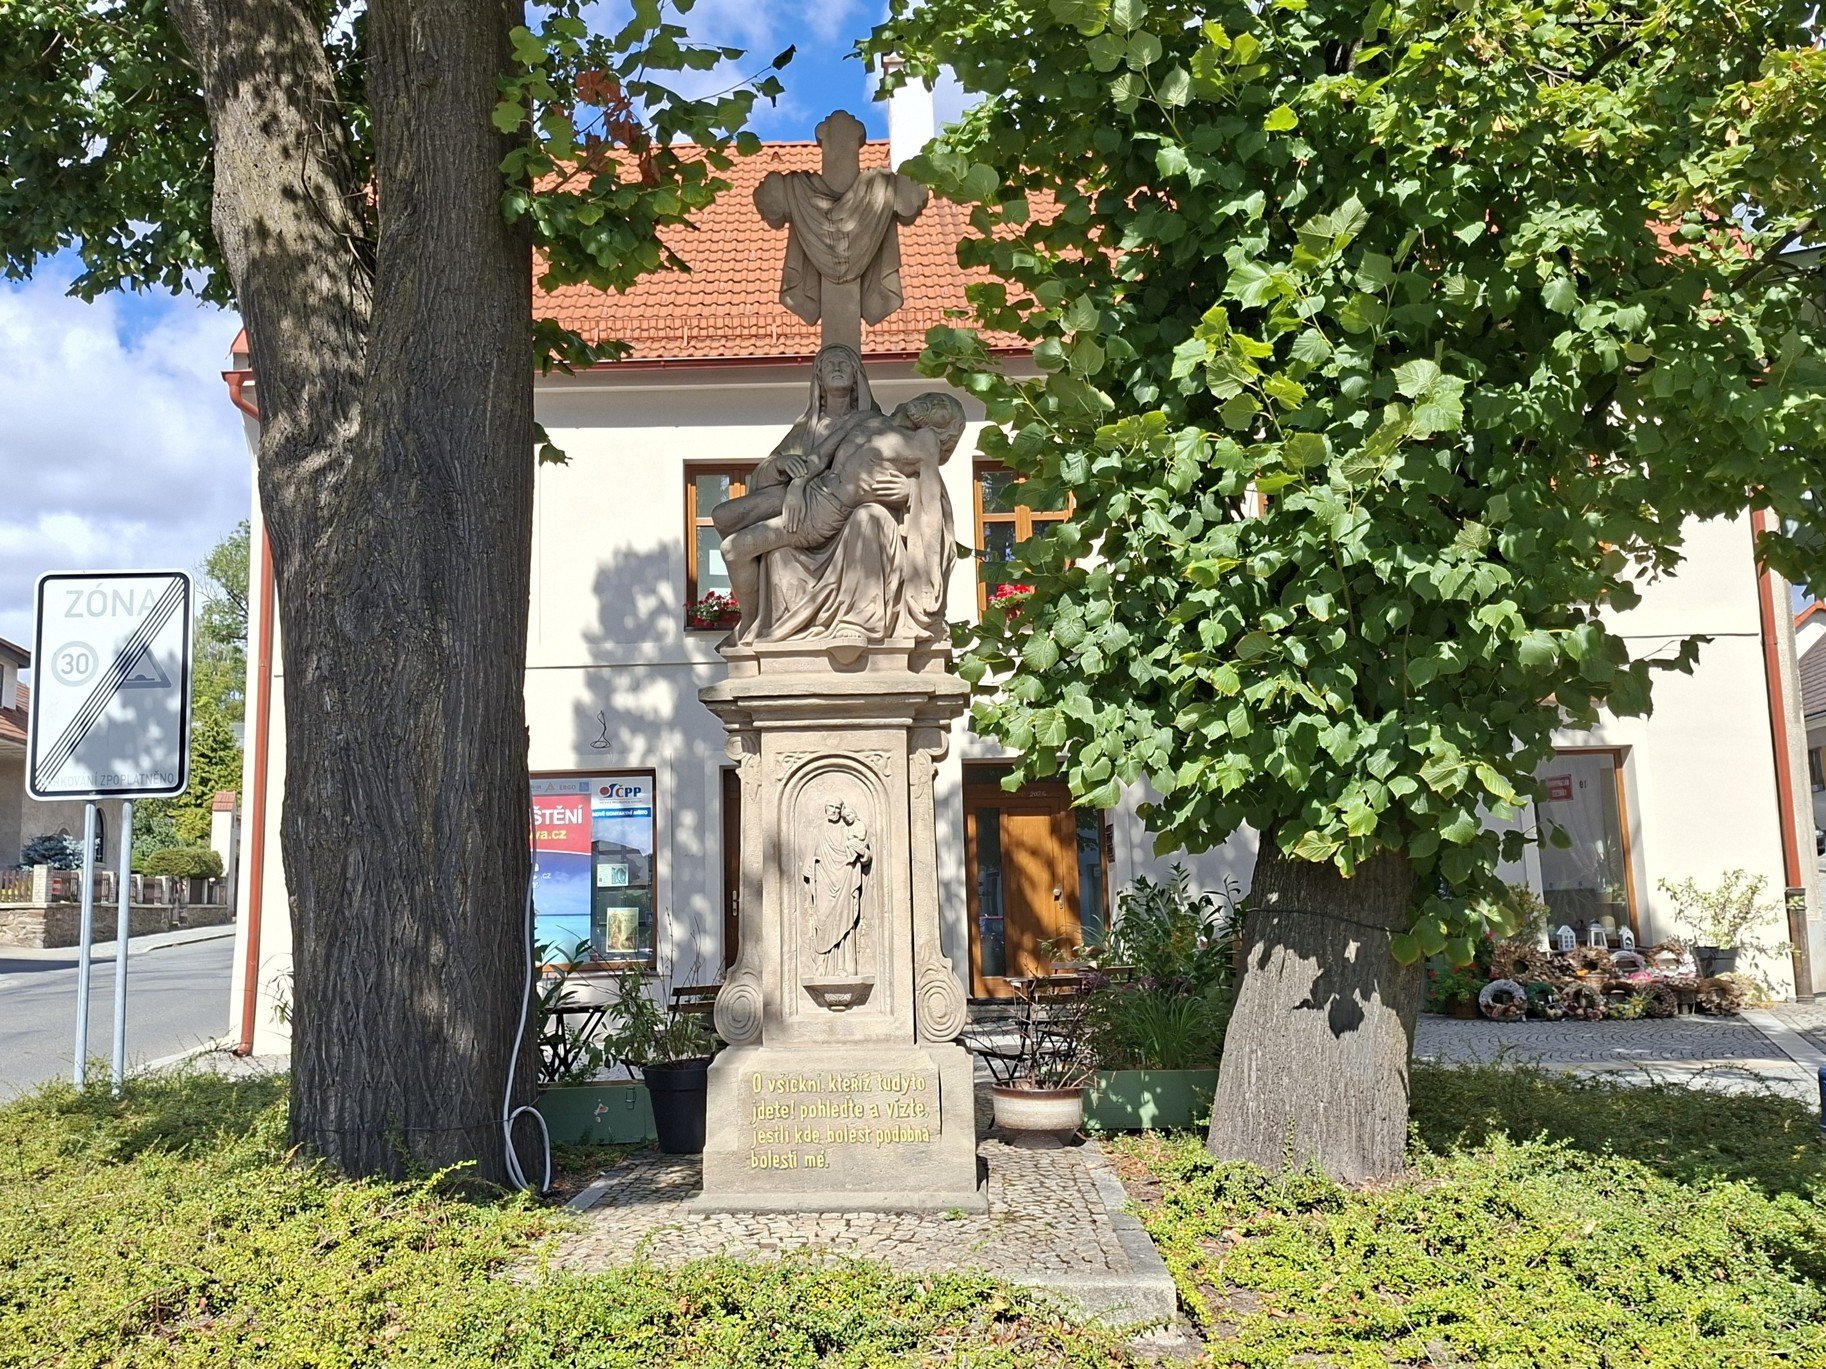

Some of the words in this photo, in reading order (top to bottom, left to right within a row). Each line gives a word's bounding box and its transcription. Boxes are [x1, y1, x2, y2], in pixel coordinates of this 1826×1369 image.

[64, 583, 158, 618] ZÓNA
[60, 653, 89, 675] 30
[100, 770, 174, 786] ZPOPLATNĚNO
[615, 784, 642, 798] ČPP
[752, 1072, 762, 1093] O
[877, 1072, 926, 1095] tudyto
[750, 1099, 796, 1124] jdete!
[869, 1103, 880, 1118] a
[751, 1124, 789, 1149] jestli
[794, 1124, 820, 1144] kde
[827, 1124, 872, 1143] bolest
[876, 1123, 930, 1148] podobná
[751, 1149, 798, 1170] bolesti
